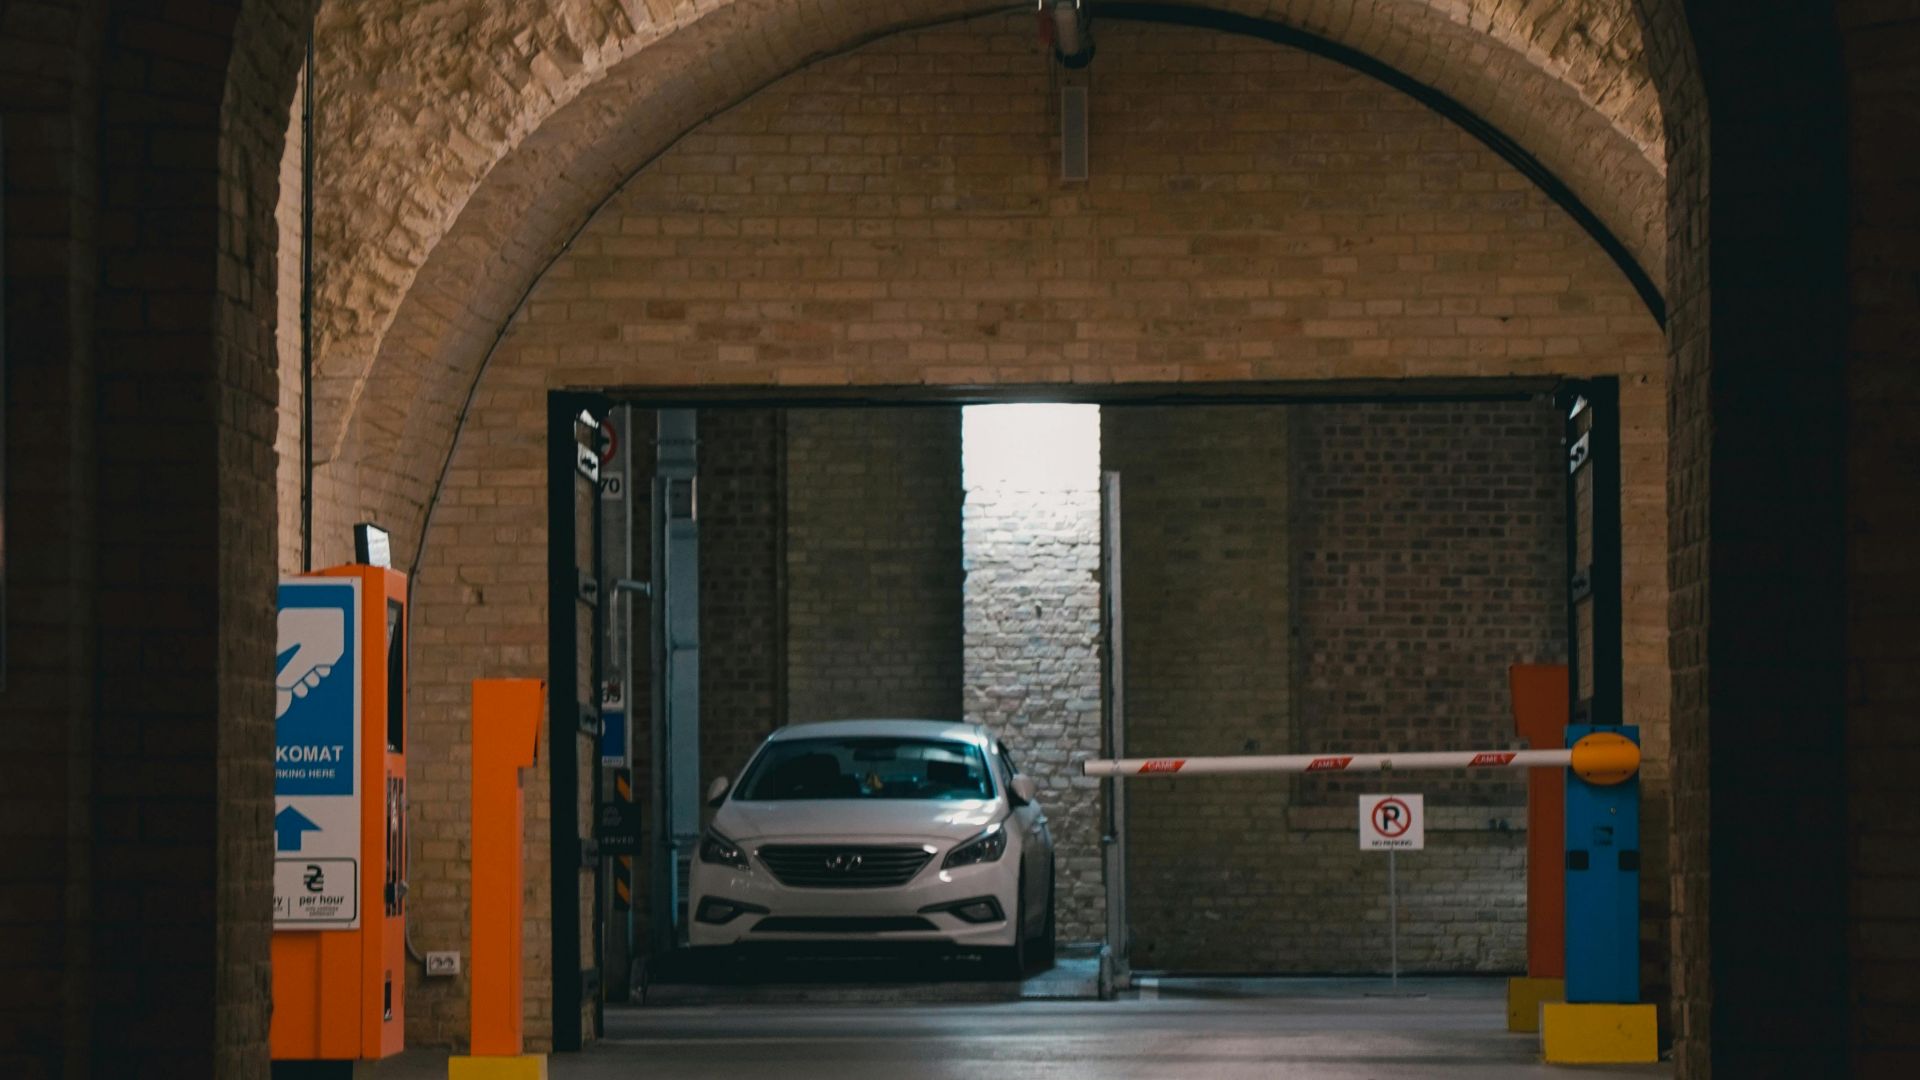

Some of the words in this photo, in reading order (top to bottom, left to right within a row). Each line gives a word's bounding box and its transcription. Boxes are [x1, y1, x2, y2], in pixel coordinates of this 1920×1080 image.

[275, 744, 344, 763] KOMAT
[308, 768, 336, 779] HERE
[299, 896, 316, 907] per
[320, 895, 344, 905] hour
